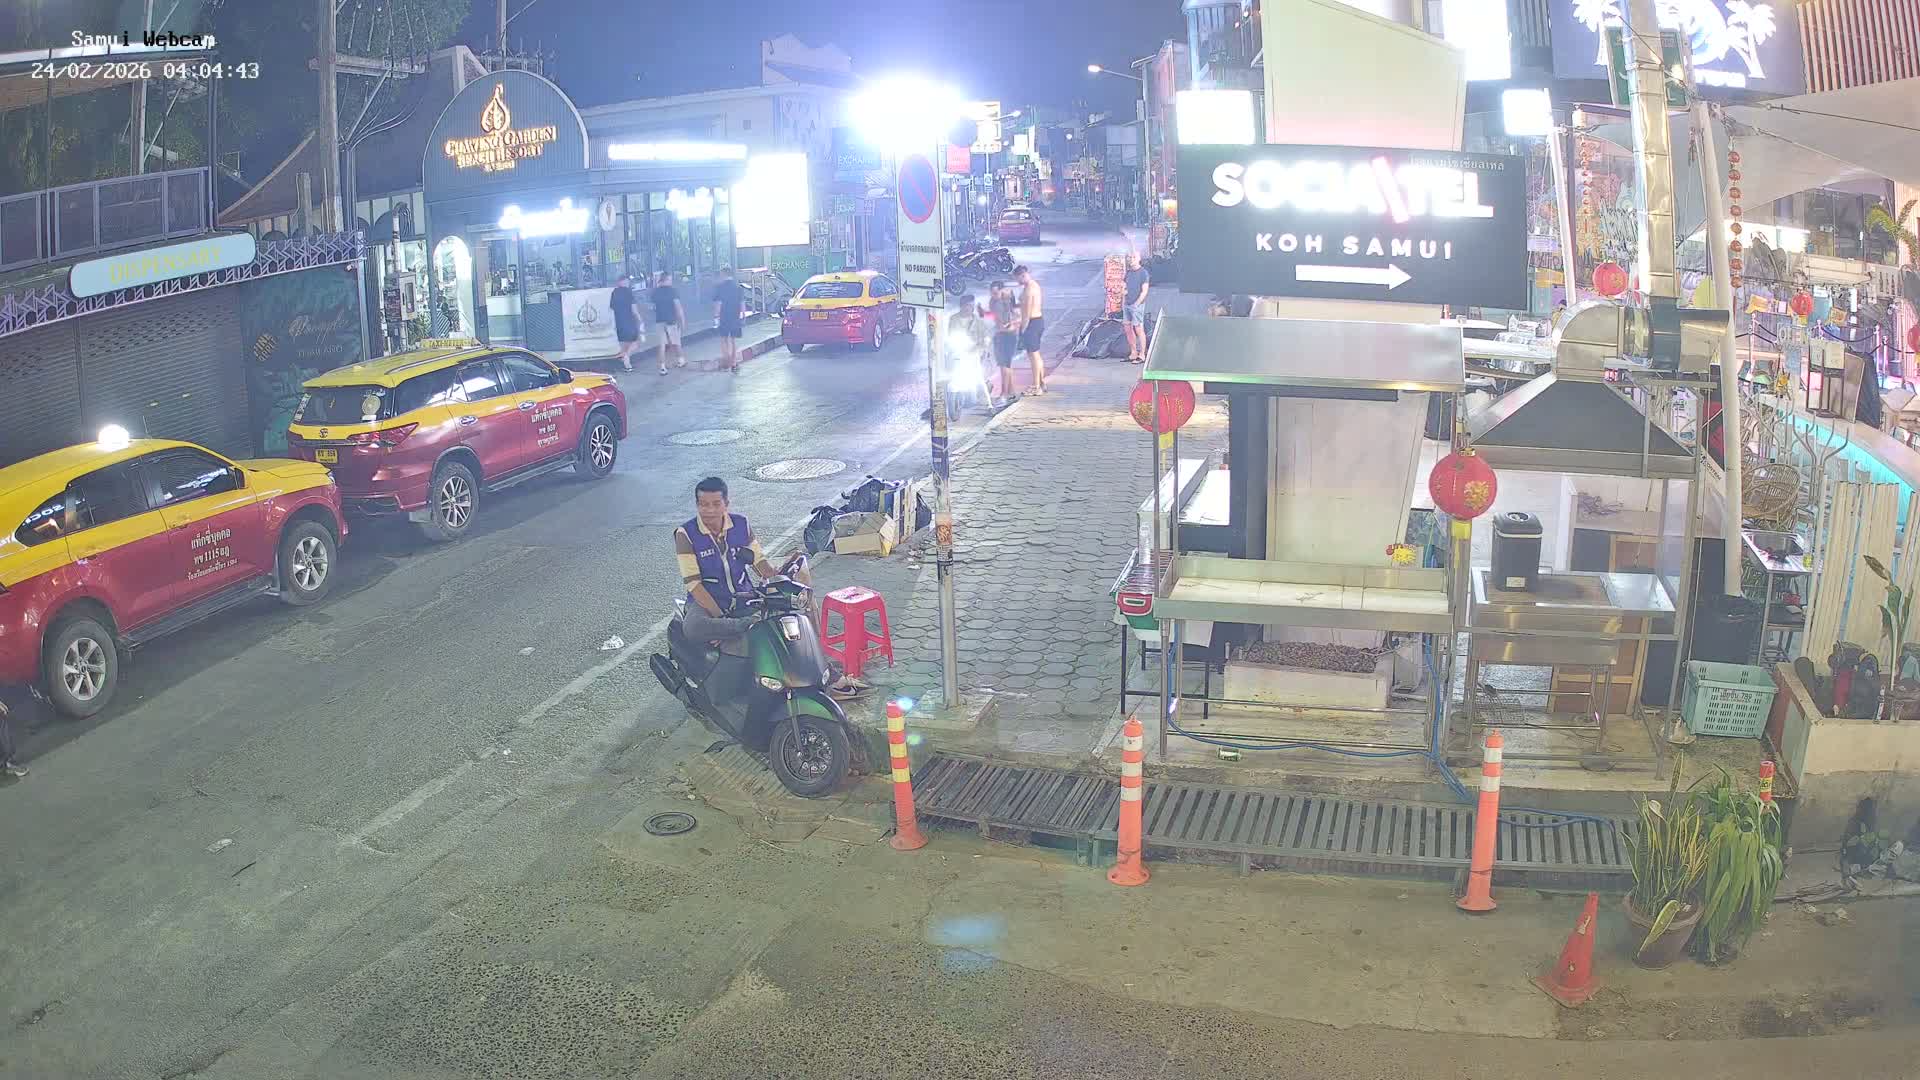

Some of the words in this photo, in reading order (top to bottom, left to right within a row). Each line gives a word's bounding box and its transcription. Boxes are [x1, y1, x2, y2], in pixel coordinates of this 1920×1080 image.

[1256, 233, 1323, 254] KOH
[1342, 236, 1452, 260] SAMUI
[110, 246, 222, 284] DISPENSARY
[772, 260, 808, 271] EXCHANGE
[905, 264, 912, 273] NO
[913, 264, 936, 274] PARKING
[191, 523, 231, 549] แท็กซี่บุคคล
